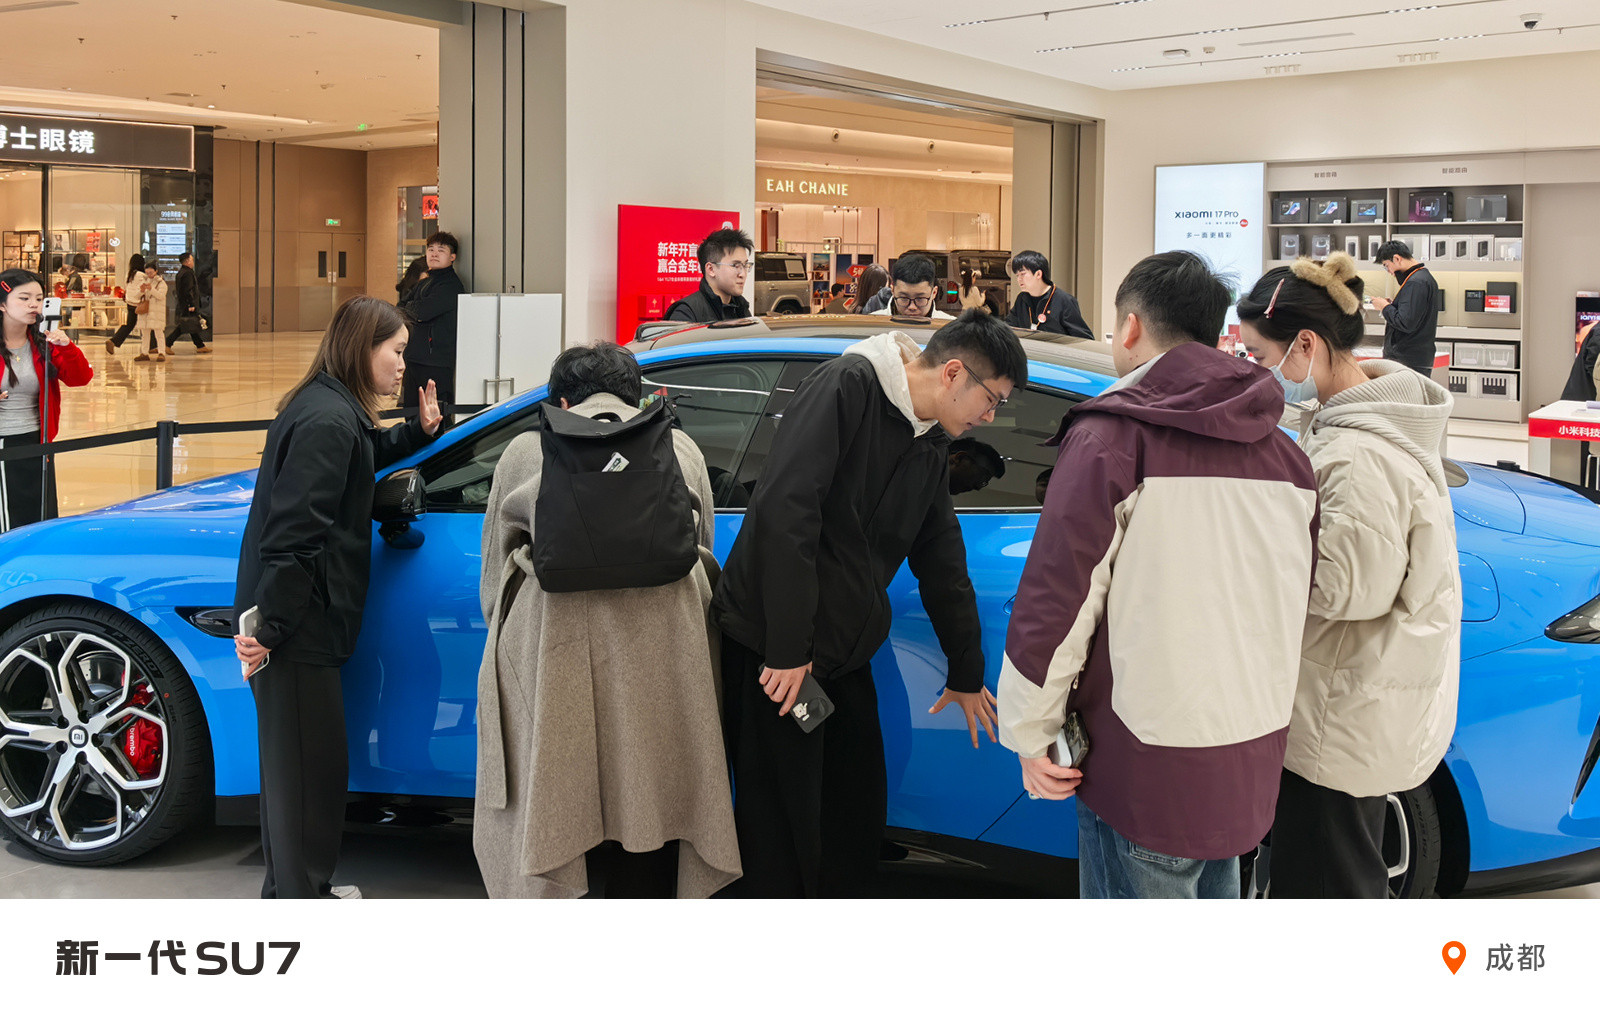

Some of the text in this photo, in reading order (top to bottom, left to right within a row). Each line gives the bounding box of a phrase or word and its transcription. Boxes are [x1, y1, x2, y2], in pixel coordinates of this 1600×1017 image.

[766, 178, 849, 196] EAH CHANIE
[1215, 210, 1223, 218] 17
[1224, 210, 1239, 218] Pro
[1558, 425, 1600, 438] 小米科技
